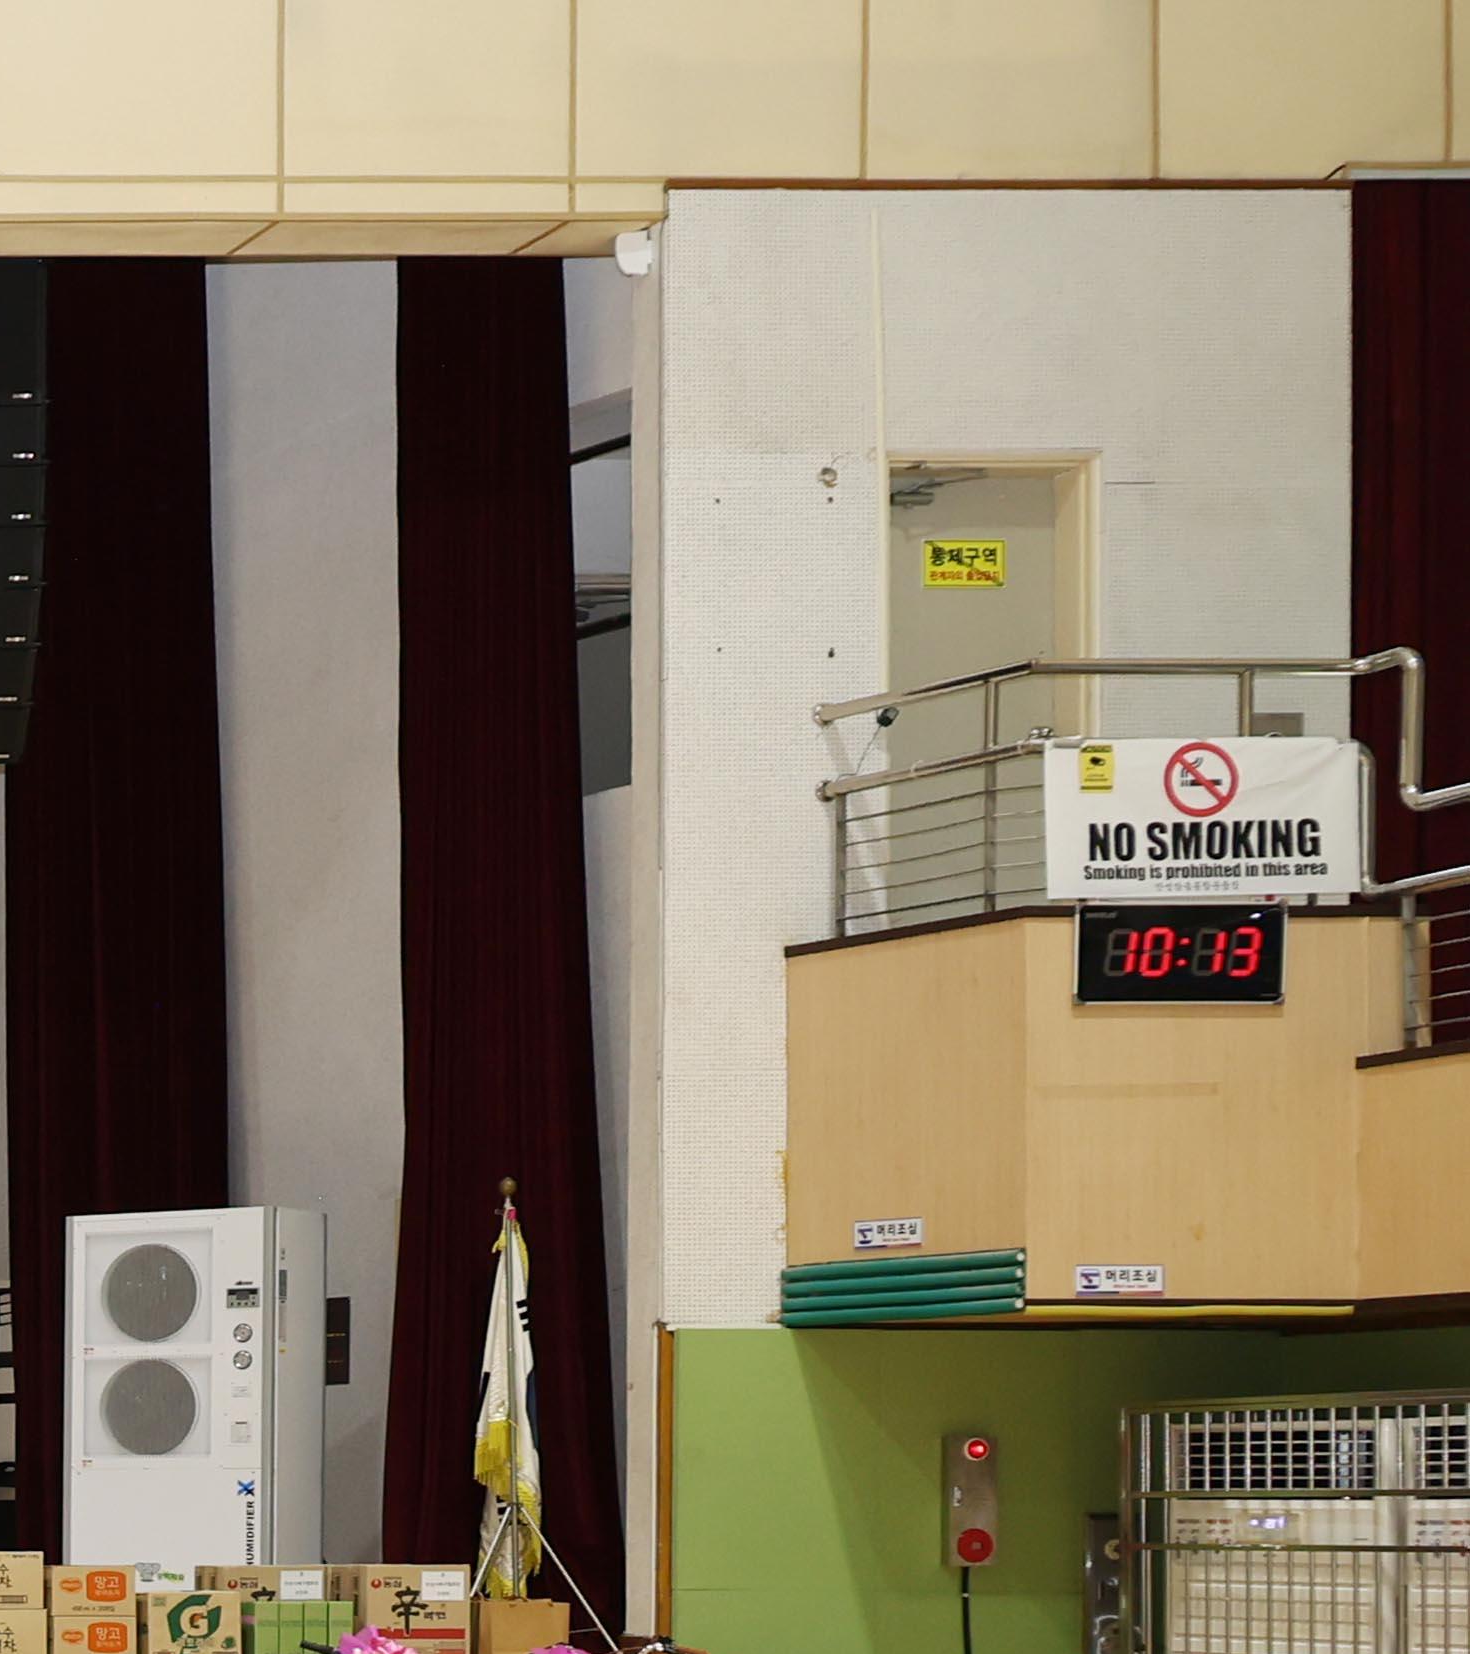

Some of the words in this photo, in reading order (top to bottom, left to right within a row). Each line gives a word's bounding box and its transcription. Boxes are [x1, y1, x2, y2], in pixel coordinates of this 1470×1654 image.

[1089, 822, 1137, 862] NO
[1147, 818, 1322, 861] SMOKING
[1083, 865, 1145, 881] Smoking
[1150, 865, 1162, 879] is
[1166, 863, 1241, 880] prohibited
[1246, 863, 1259, 877] in
[1262, 861, 1291, 876] this
[1295, 863, 1328, 876] area
[1124, 926, 1265, 978] 10:13
[877, 1222, 918, 1236] 머리조심
[1106, 1269, 1157, 1283] 머리조심
[95, 1575, 119, 1589] 망고
[391, 1585, 429, 1636] 辛
[95, 1627, 121, 1641] 망고
